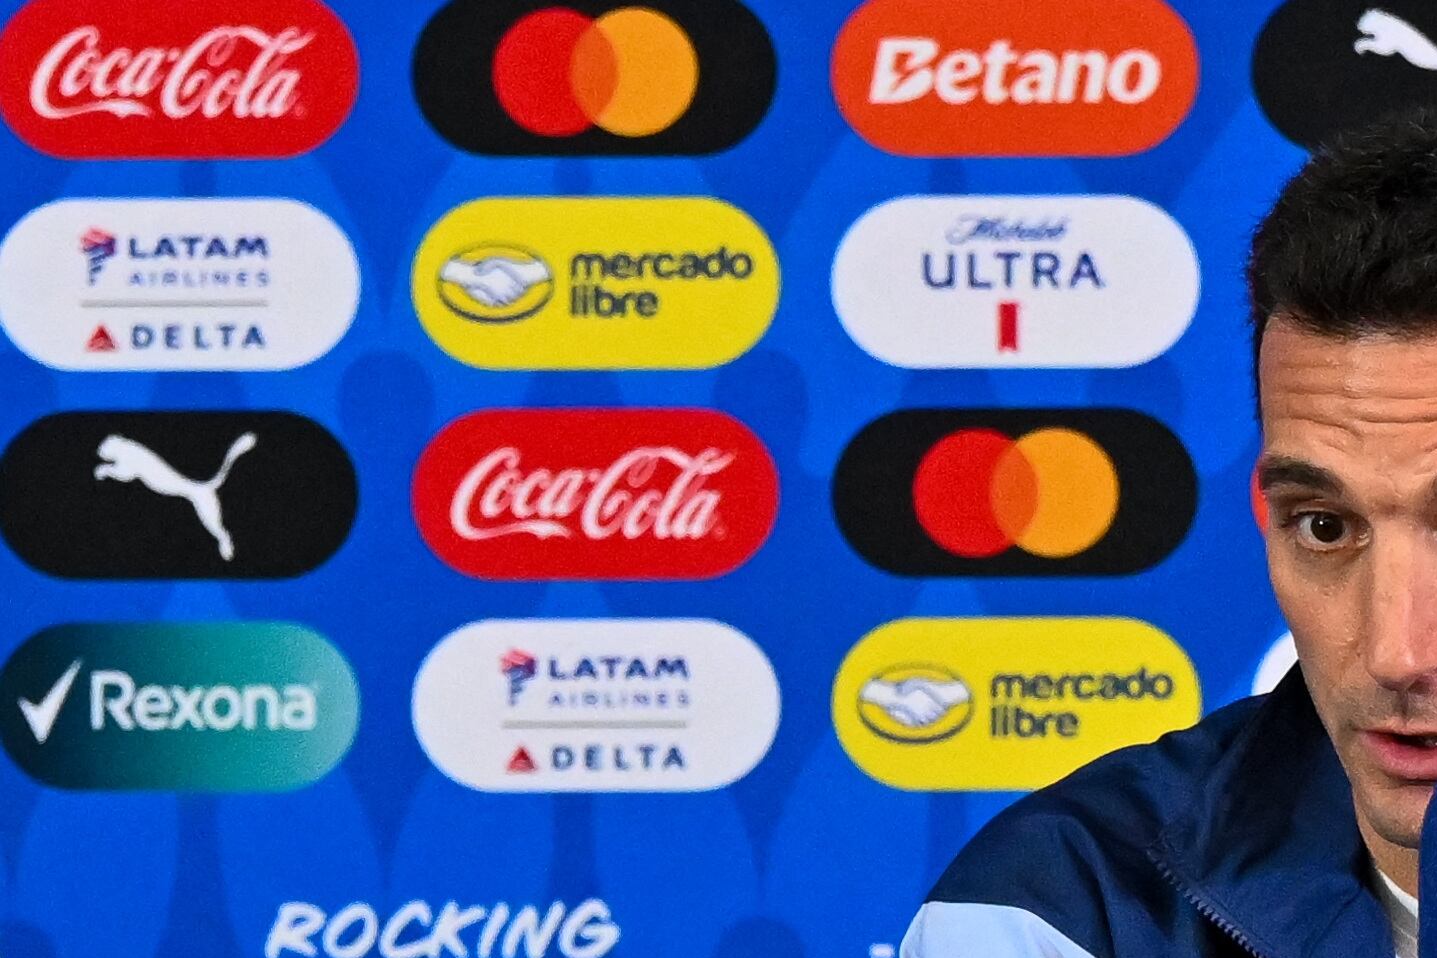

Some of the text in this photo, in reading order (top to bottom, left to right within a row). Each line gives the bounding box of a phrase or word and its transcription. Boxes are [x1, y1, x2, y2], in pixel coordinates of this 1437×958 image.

[30, 26, 314, 119] Coca-Cola
[869, 37, 1161, 104] Betano
[129, 237, 268, 259] LATAM
[570, 246, 754, 280] mercado
[129, 269, 270, 287] AIRLINES
[923, 252, 1105, 289] ULTRA
[570, 284, 659, 318] libre
[131, 324, 264, 349] DELTA
[450, 447, 733, 540] Coca-Cola
[549, 657, 688, 680] LATAM
[990, 667, 1174, 700] mercado
[90, 671, 317, 731] Rexona
[549, 690, 689, 708] AIRLINES
[991, 704, 1079, 738] libre
[551, 745, 685, 770] DELTA
